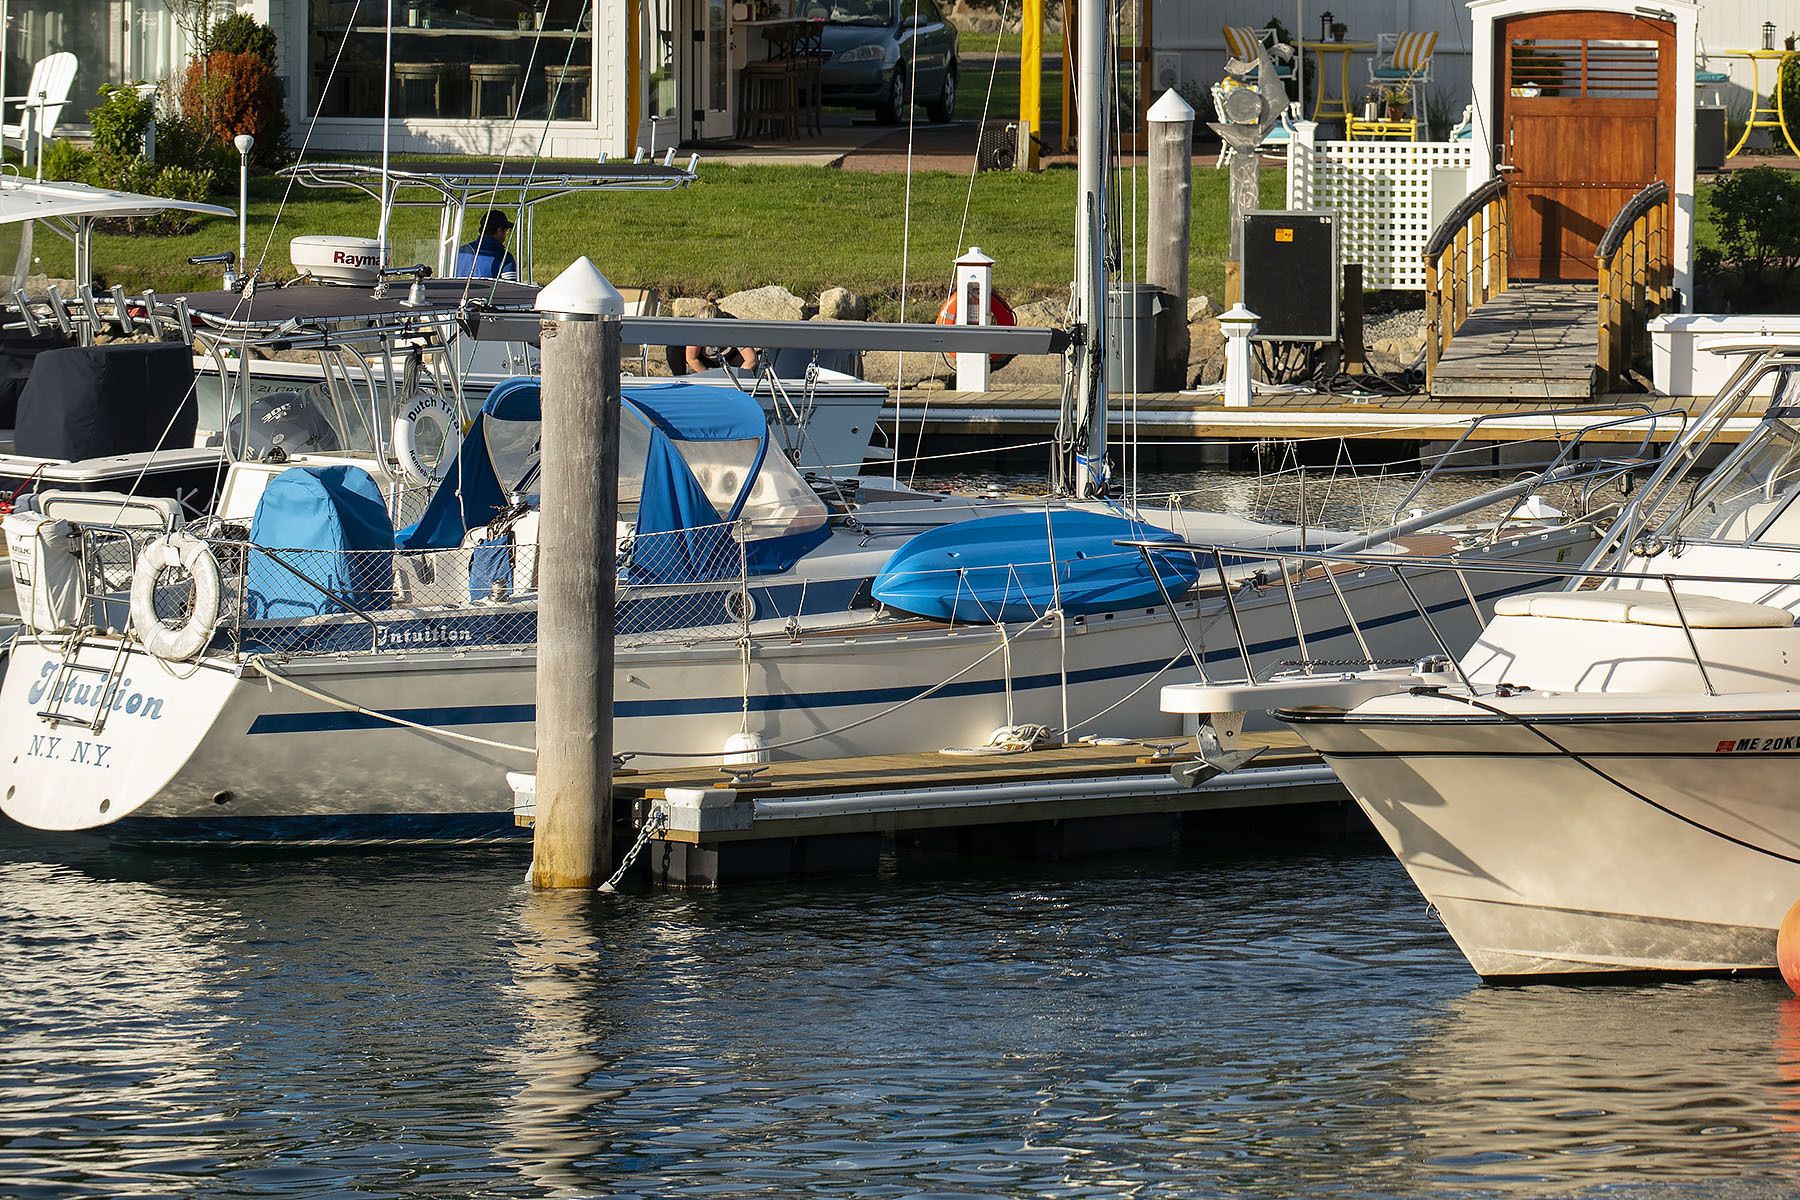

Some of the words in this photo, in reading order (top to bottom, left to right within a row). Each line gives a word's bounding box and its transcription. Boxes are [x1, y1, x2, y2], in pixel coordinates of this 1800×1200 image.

[407, 396, 437, 423] Dutch
[377, 625, 473, 647] Intuition
[28, 660, 164, 720] Intuition
[27, 734, 62, 759] N.Y.
[70, 740, 112, 769] N.Y.
[1736, 738, 1760, 751] ME
